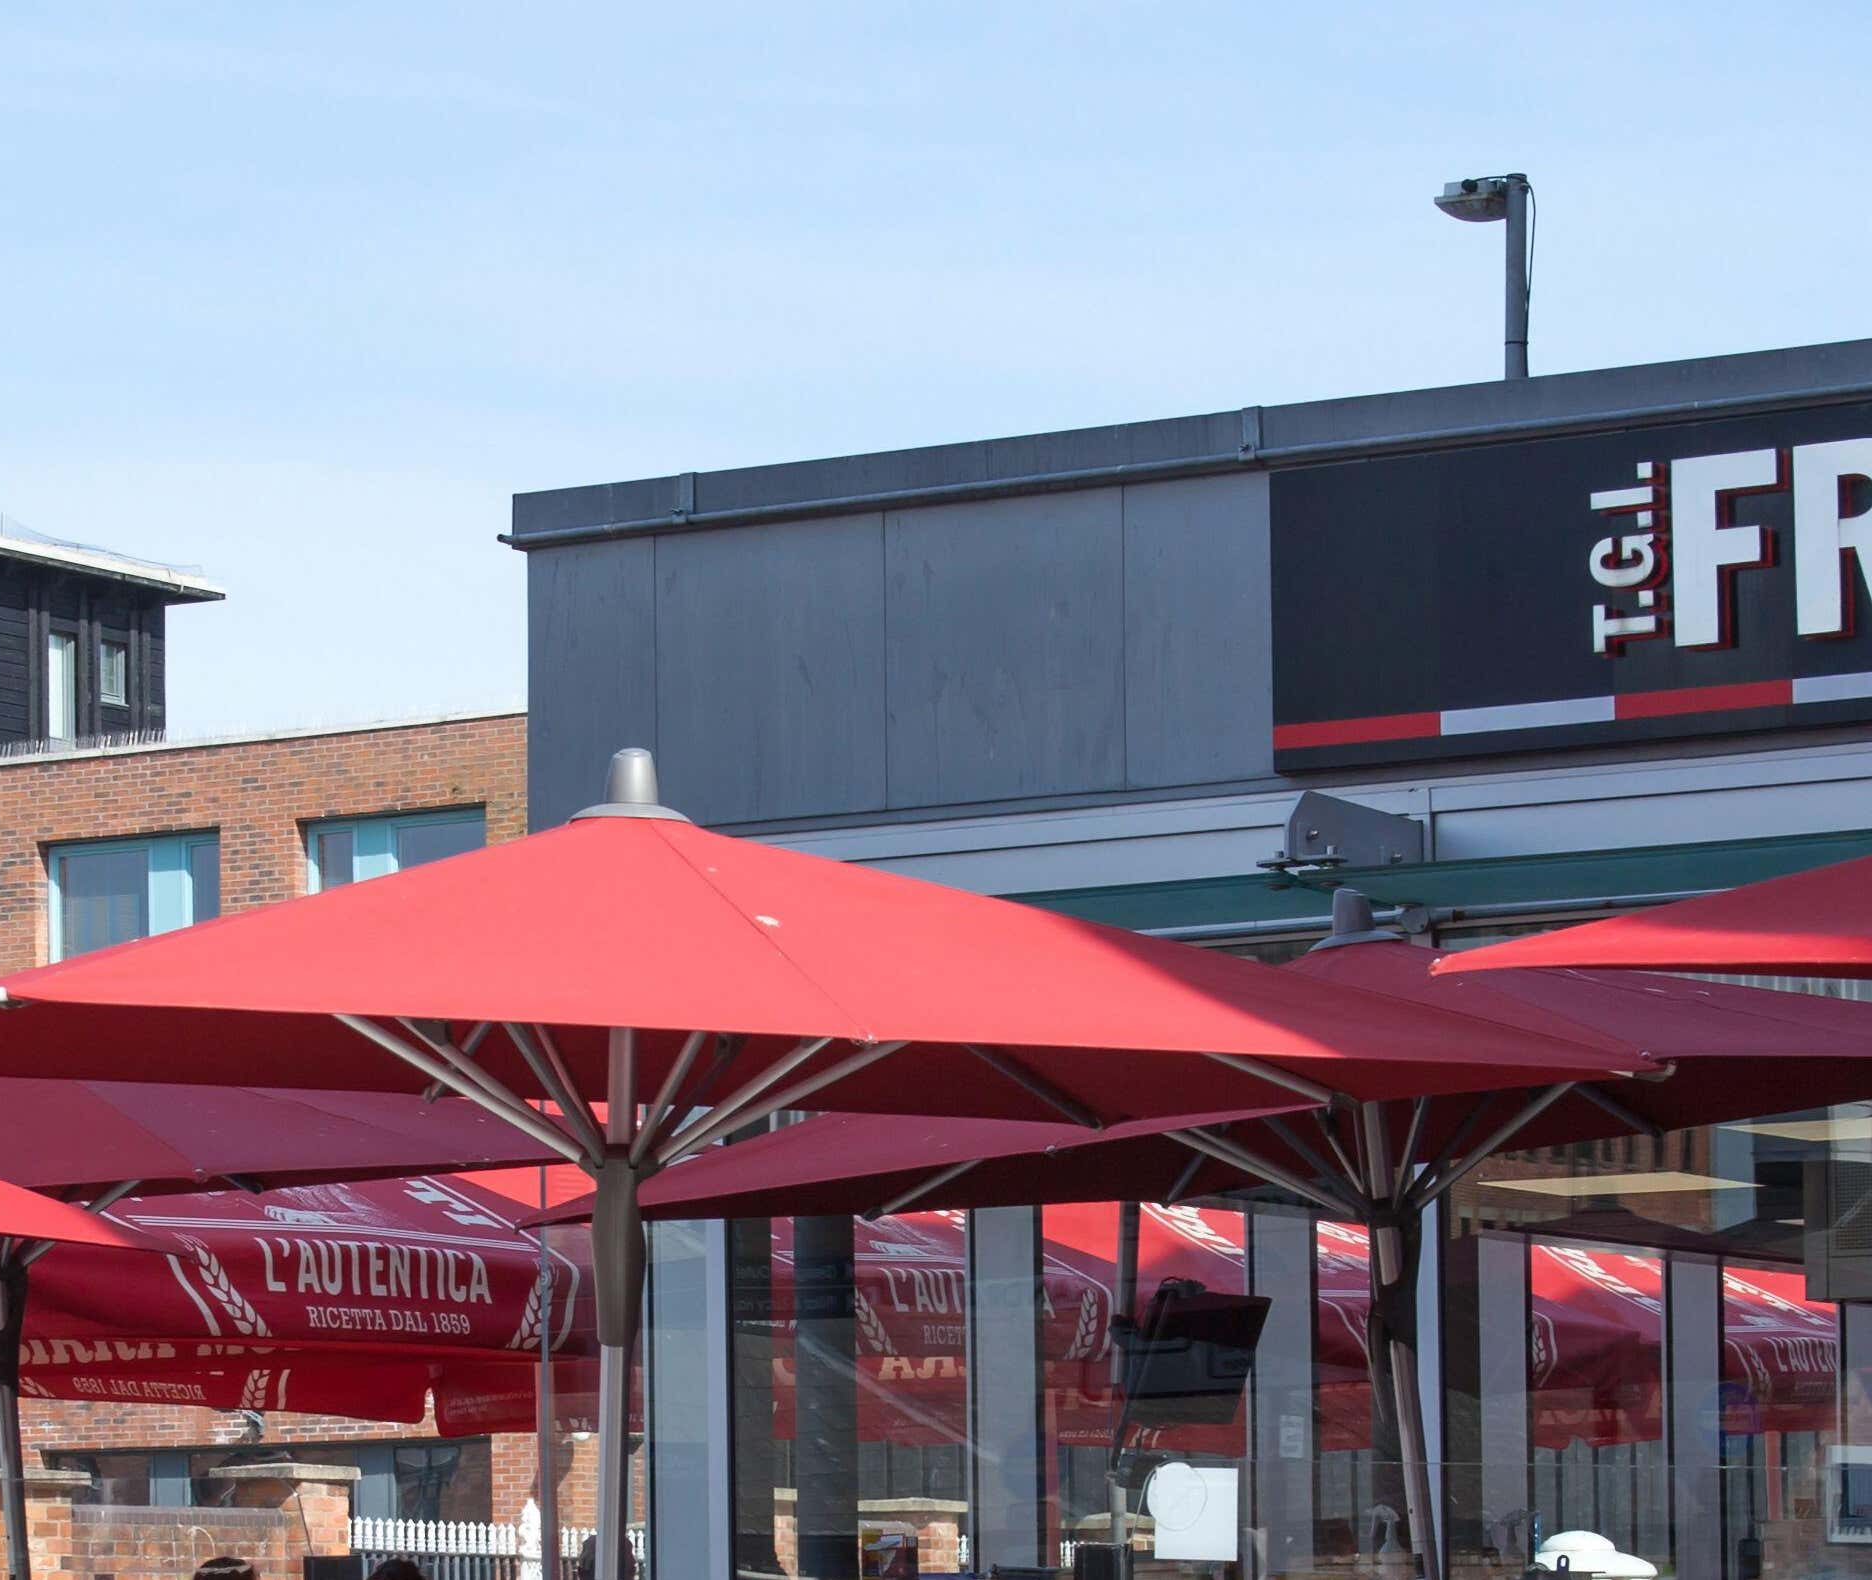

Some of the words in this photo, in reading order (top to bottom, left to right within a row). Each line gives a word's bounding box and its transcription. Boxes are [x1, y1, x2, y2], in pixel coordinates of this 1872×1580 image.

[253, 1236, 493, 1305] L'AUTENTICA
[306, 1305, 388, 1332] RICETTA
[388, 1310, 427, 1333] DAL
[431, 1311, 471, 1337] 1859
